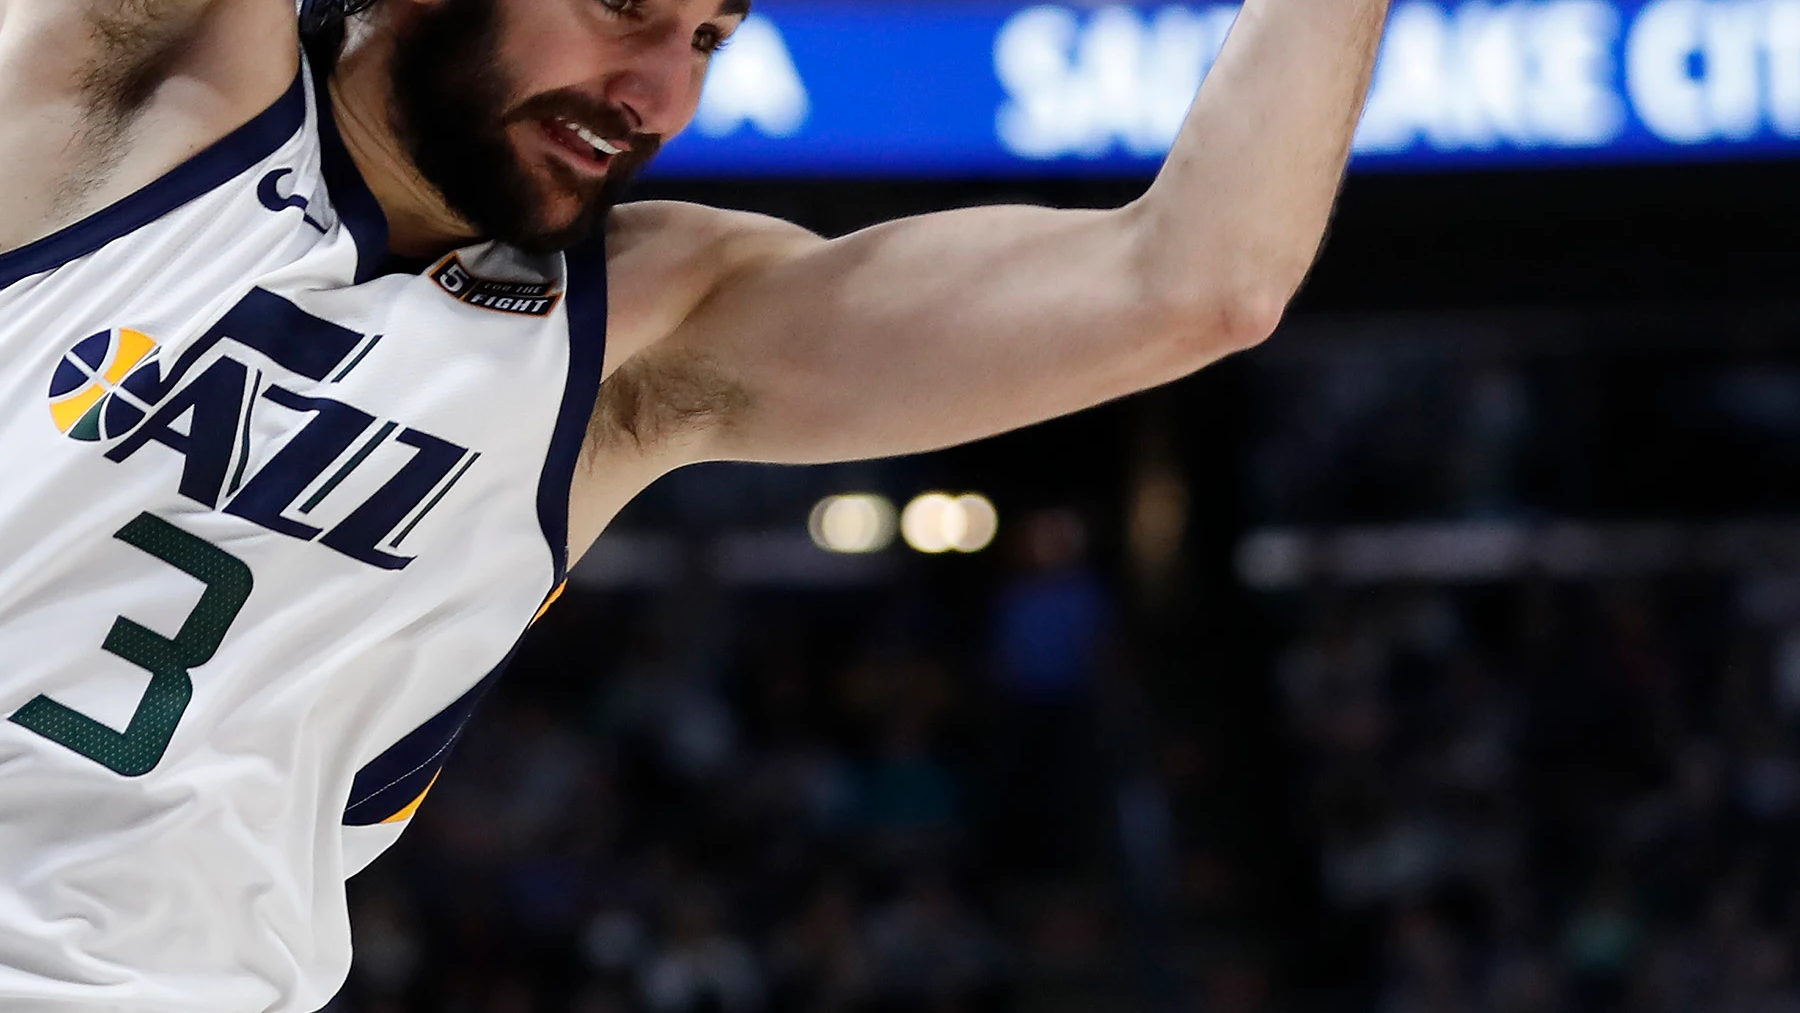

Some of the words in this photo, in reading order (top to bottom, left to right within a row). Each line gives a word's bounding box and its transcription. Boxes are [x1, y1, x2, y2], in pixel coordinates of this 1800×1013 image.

[439, 263, 470, 293] 5
[470, 293, 549, 313] FIGHT
[48, 285, 481, 570] JAZZ
[8, 510, 254, 777] 3
